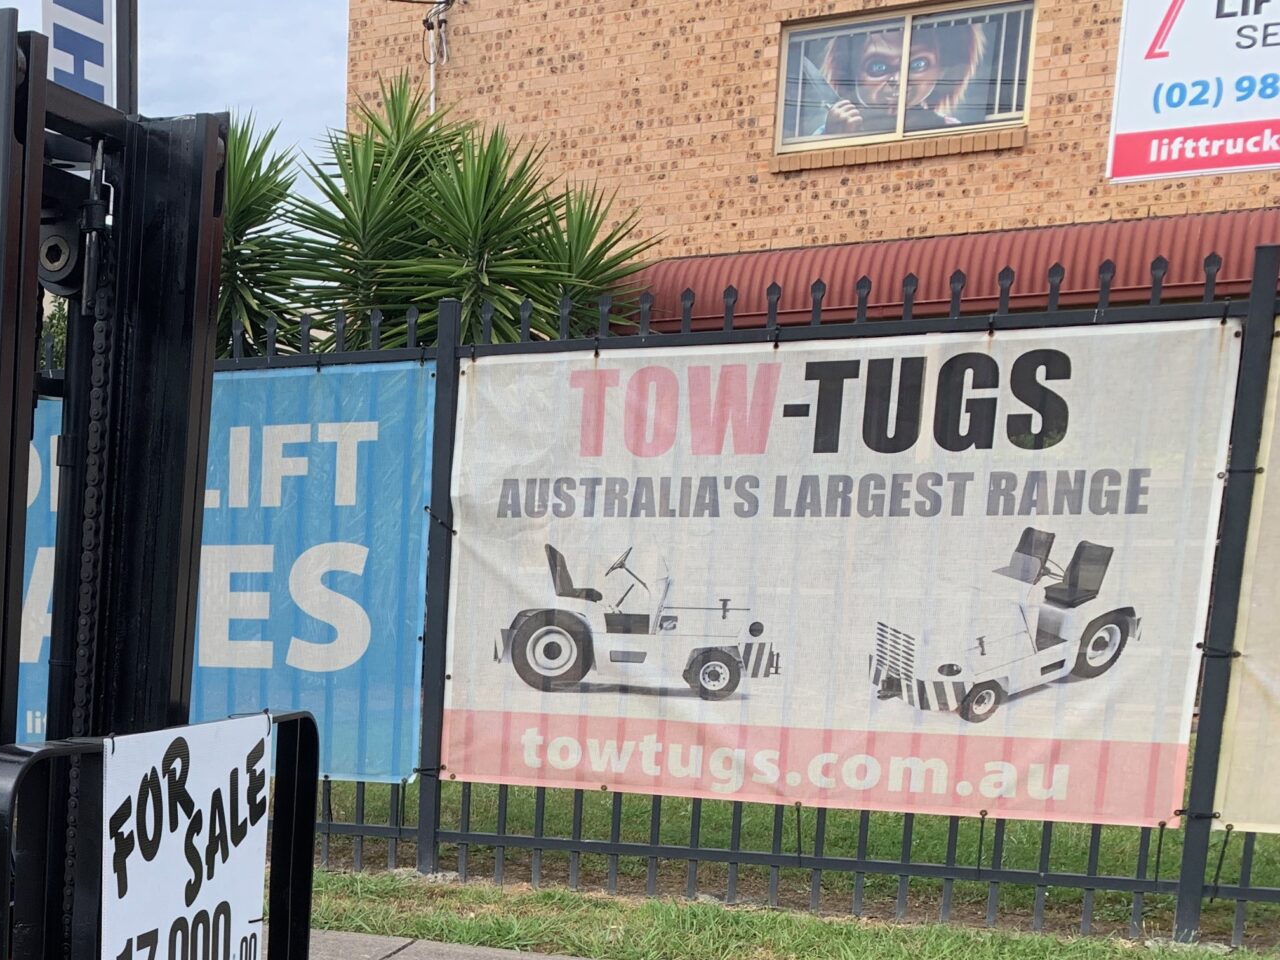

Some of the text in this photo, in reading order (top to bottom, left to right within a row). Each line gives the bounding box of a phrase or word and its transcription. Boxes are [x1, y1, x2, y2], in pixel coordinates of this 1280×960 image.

[53, 0, 104, 104] H
[1152, 73, 1280, 114] (02) 98
[569, 348, 1072, 457] TOW-TUGS
[497, 467, 1152, 519] AUSTRALIA'S LARGEST RANGE
[521, 723, 1069, 801] towtugs.com.au
[109, 736, 196, 900] FOR
[184, 737, 267, 908] SALE
